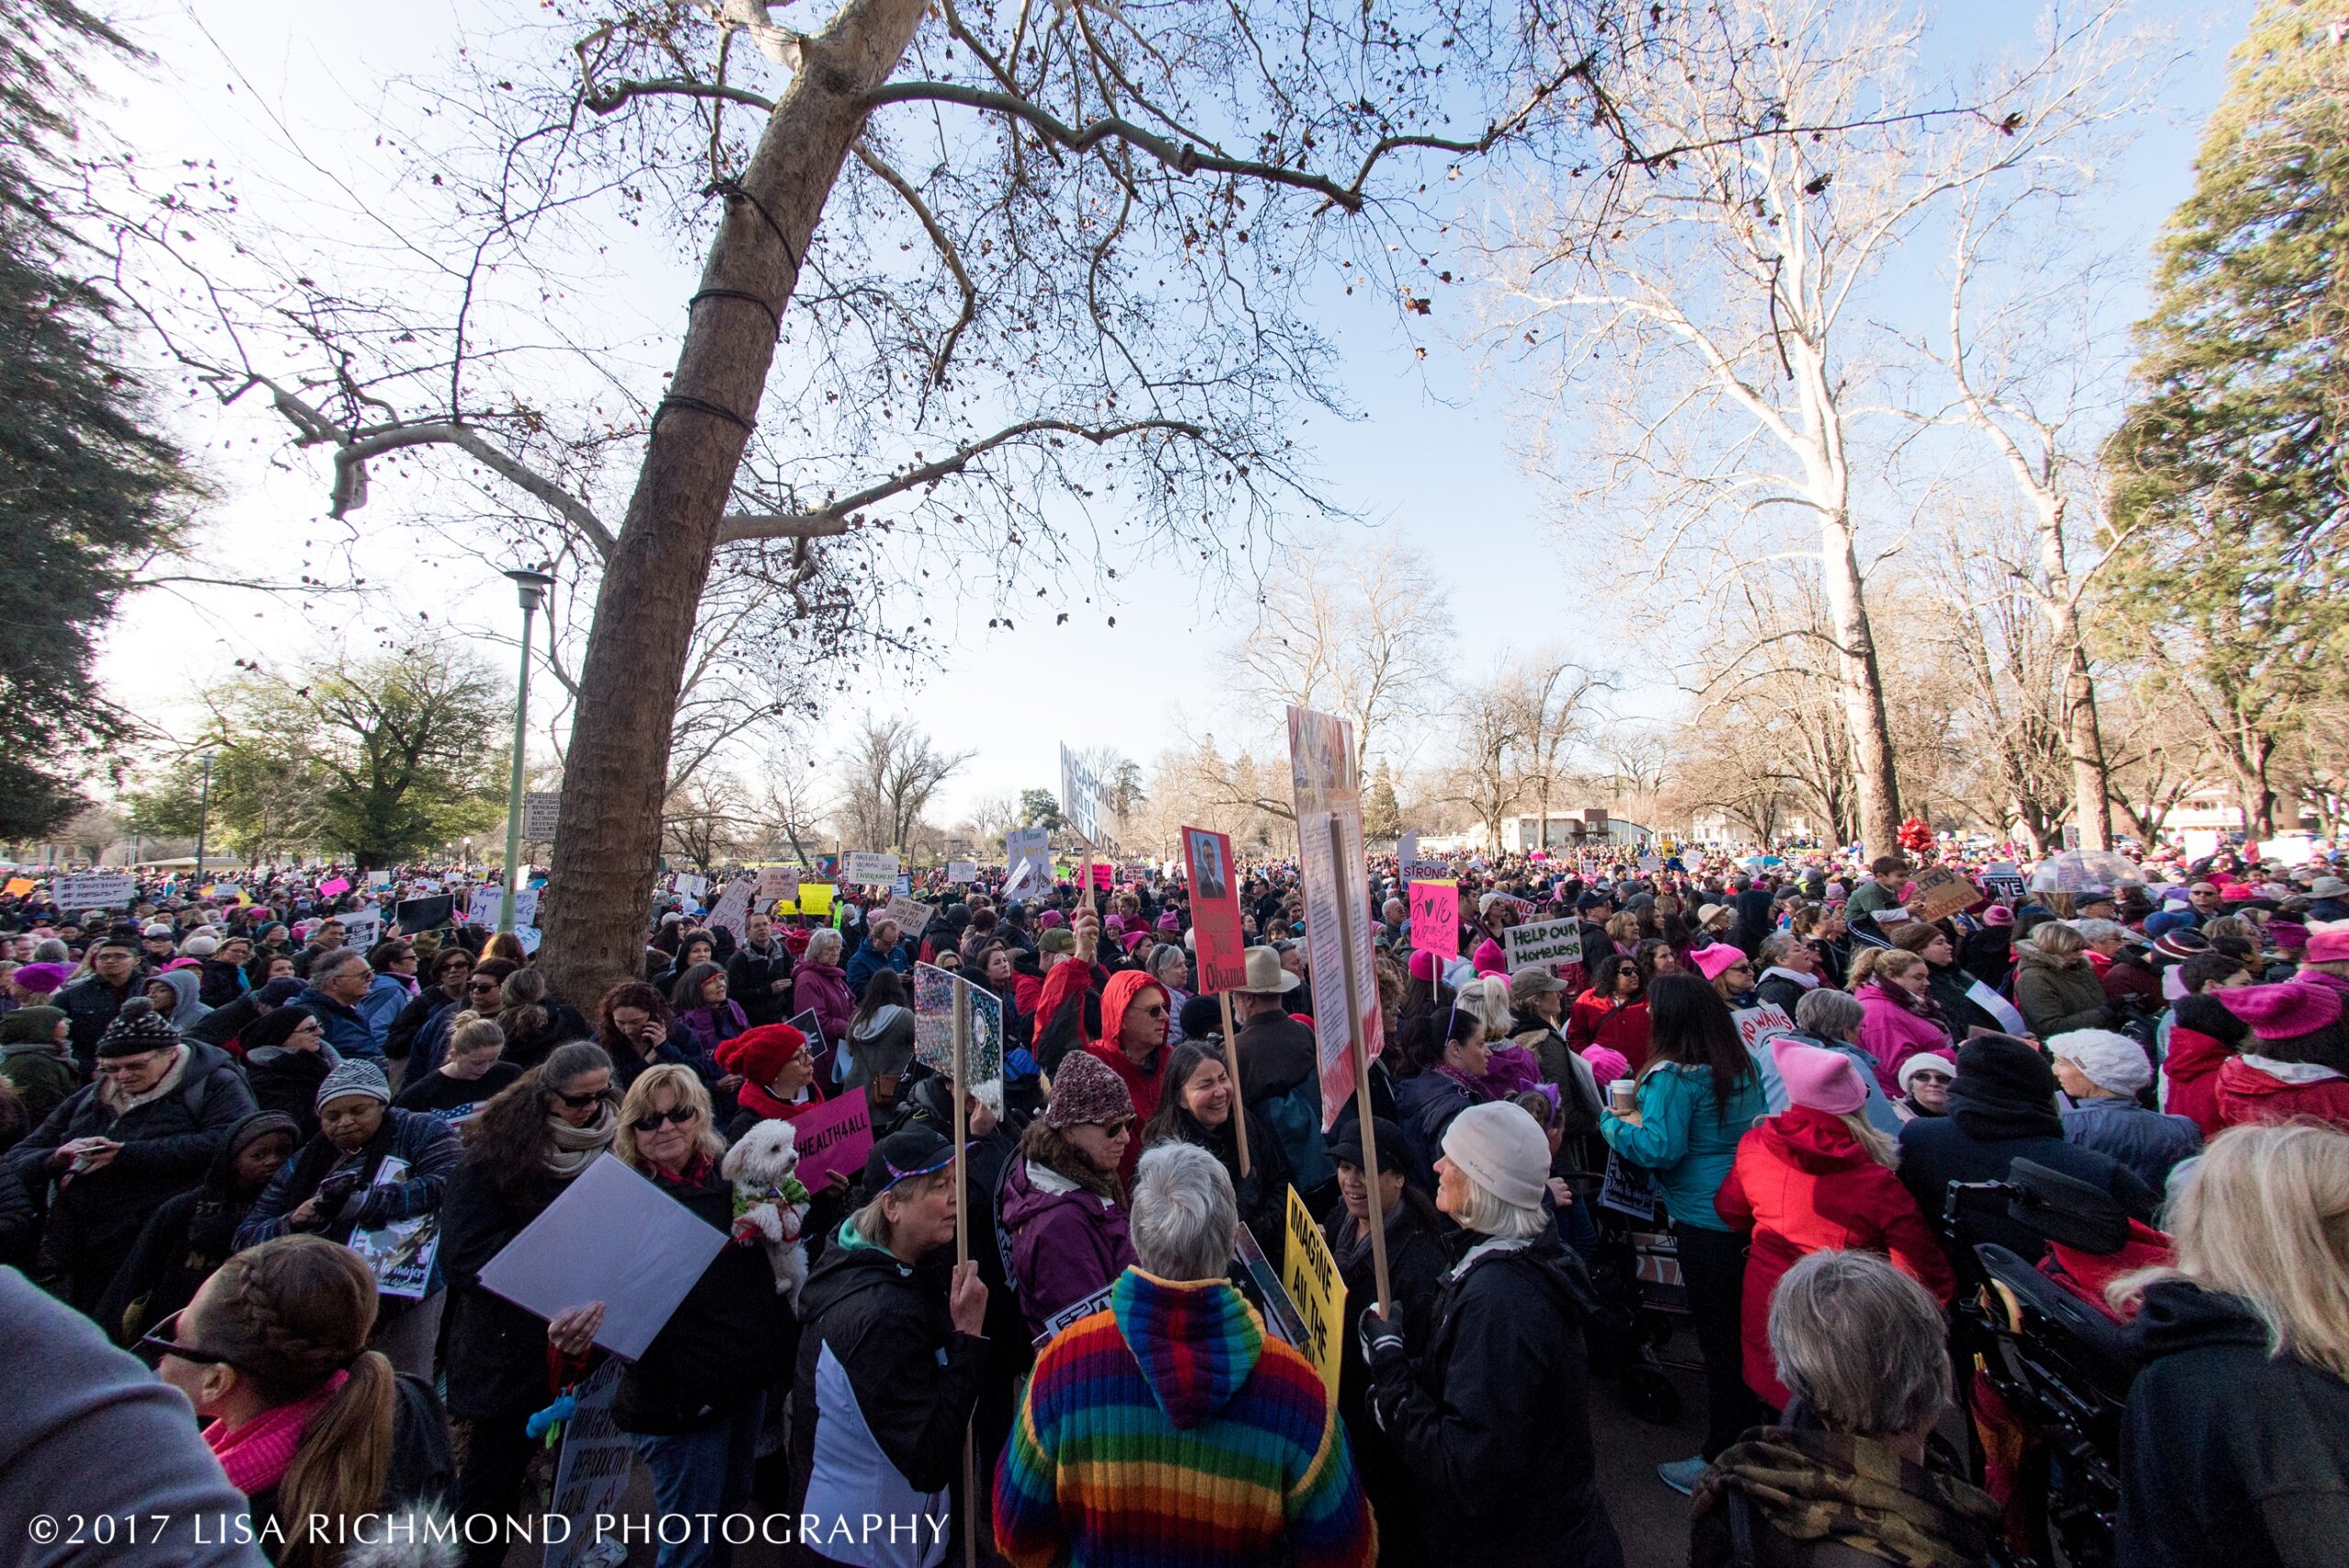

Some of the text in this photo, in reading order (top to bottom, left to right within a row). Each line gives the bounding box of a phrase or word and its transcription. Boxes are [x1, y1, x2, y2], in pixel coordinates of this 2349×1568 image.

[1074, 759, 1115, 814] CAPONE
[1011, 831, 1018, 843] 1
[1088, 818, 1120, 861] TAXES
[1014, 848, 1020, 859] 1
[1404, 865, 1448, 879] STRONG
[478, 887, 502, 899] Trump
[1550, 923, 1578, 939] OUR
[1206, 962, 1248, 991] Obama
[1741, 1020, 1756, 1048] NO
[794, 1112, 867, 1160] HEALTH4ALL
[1310, 1293, 1328, 1364] THE
